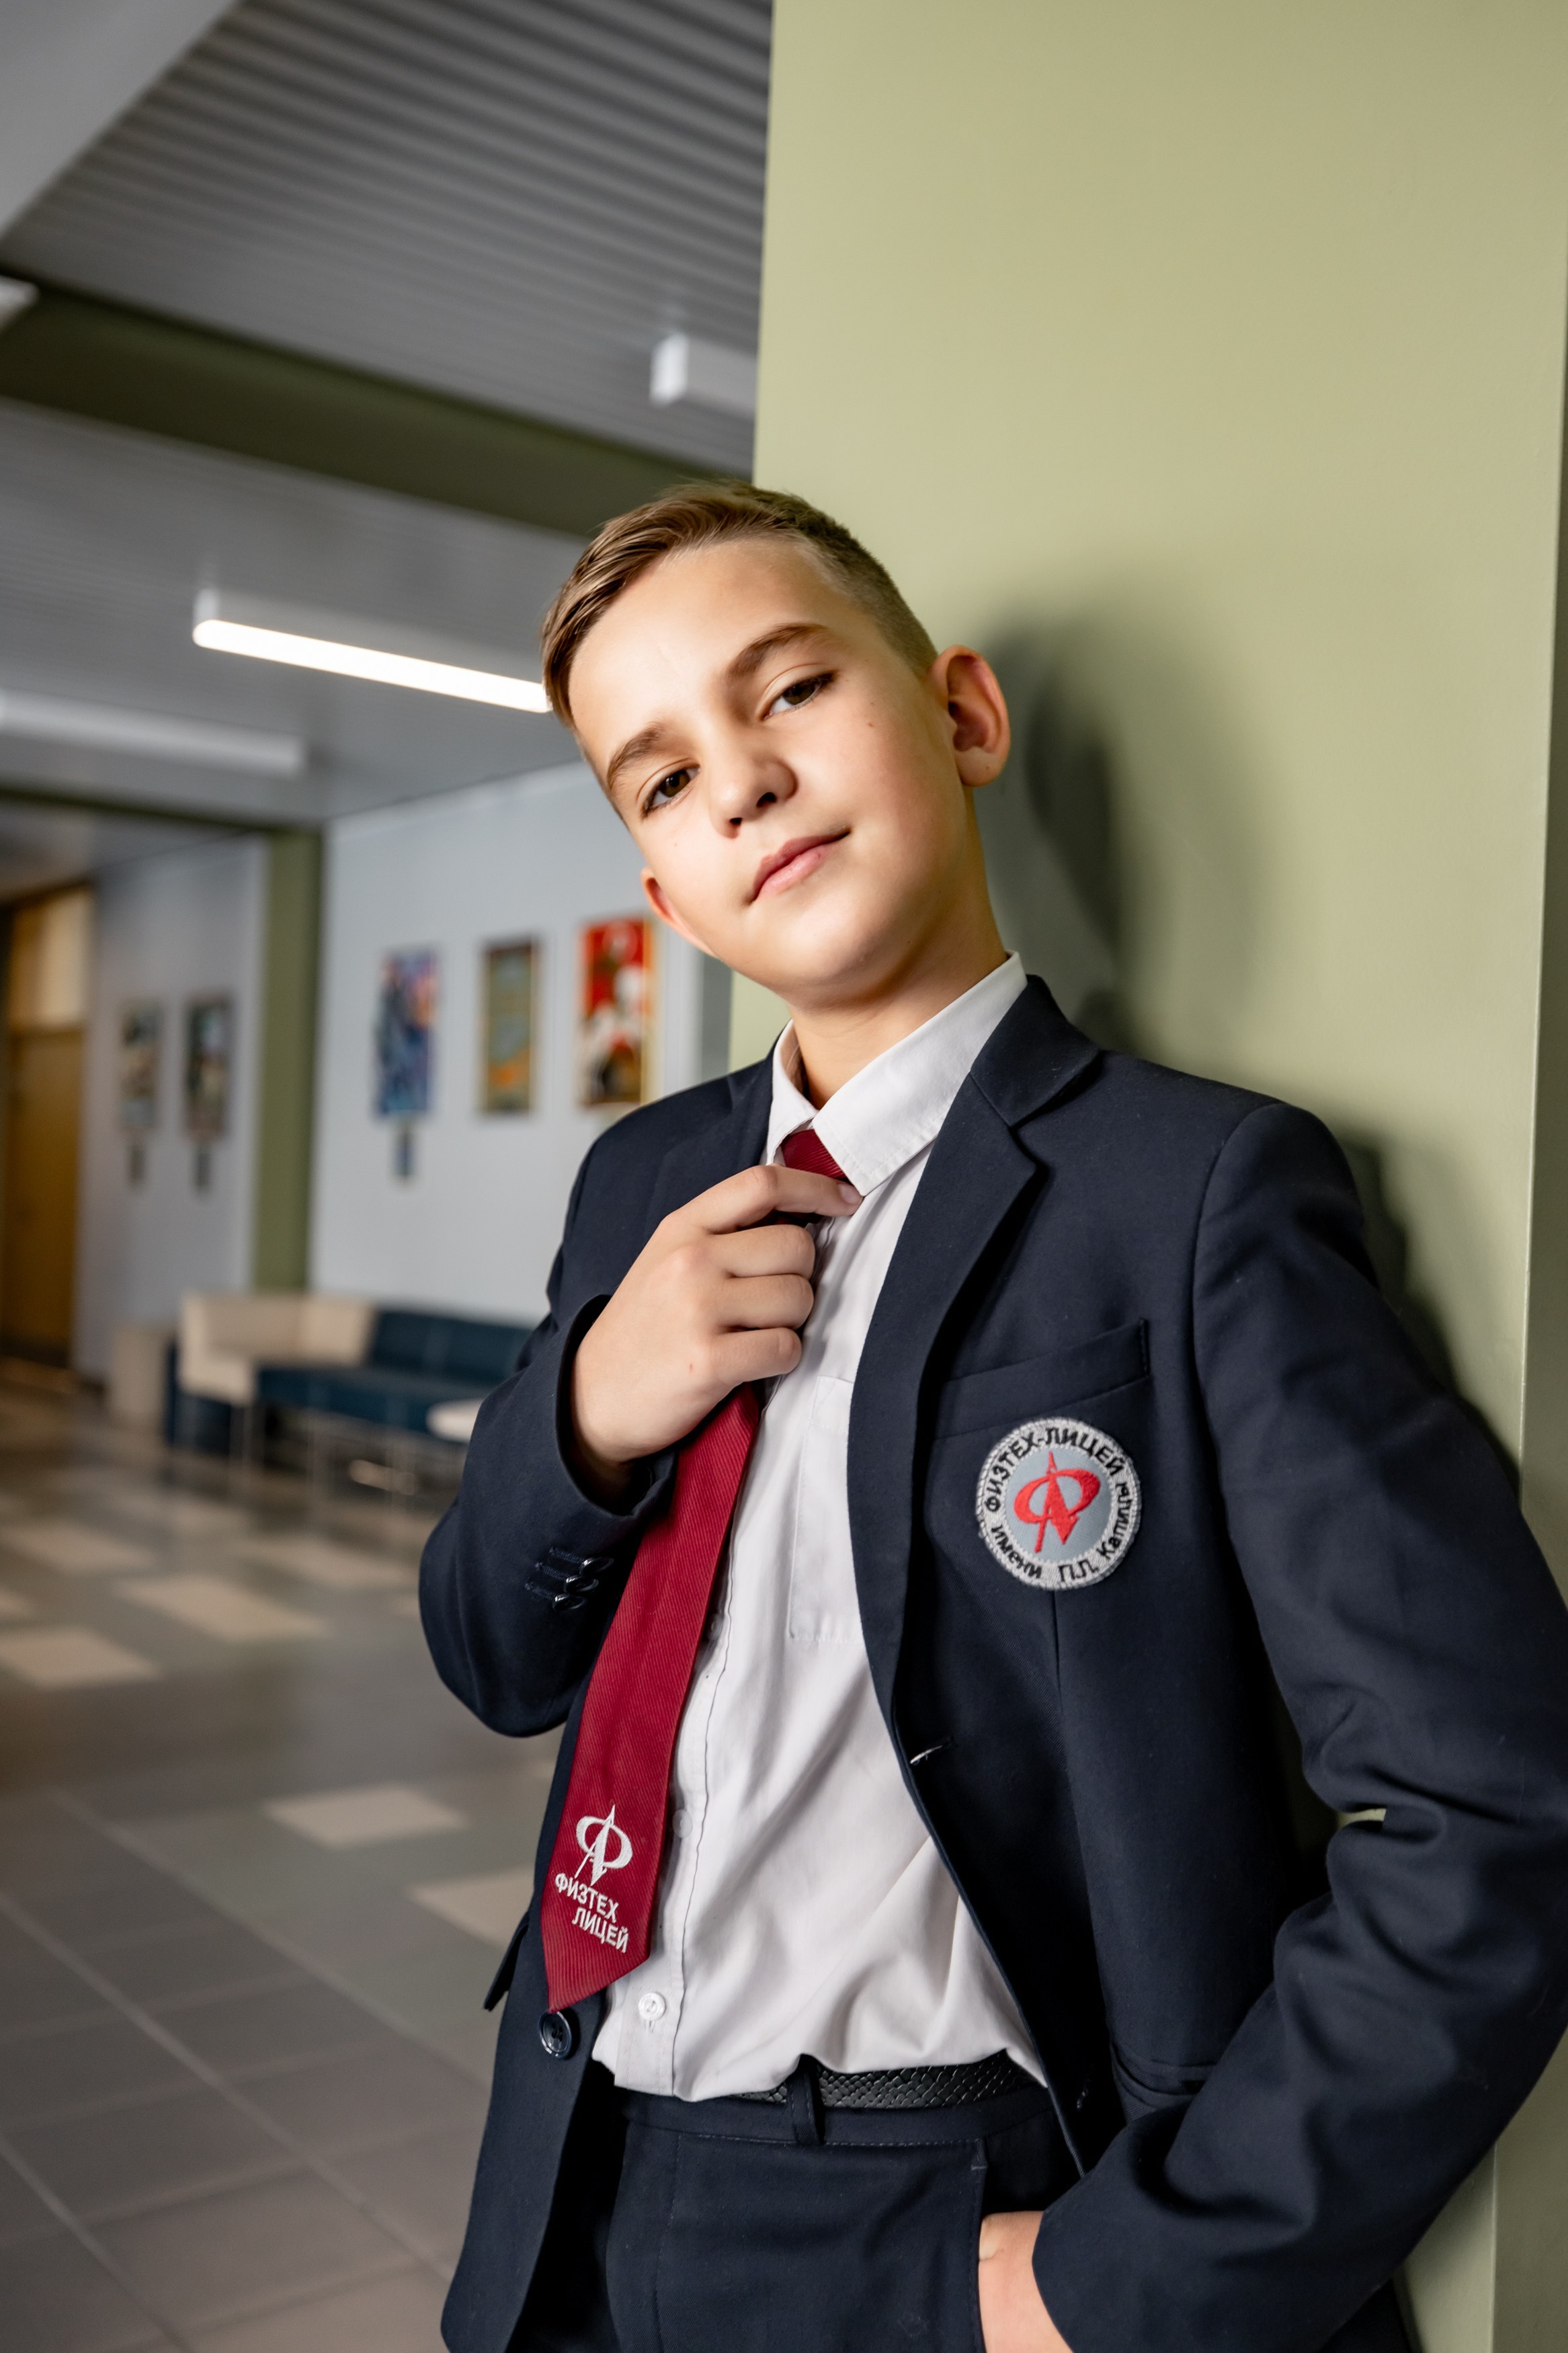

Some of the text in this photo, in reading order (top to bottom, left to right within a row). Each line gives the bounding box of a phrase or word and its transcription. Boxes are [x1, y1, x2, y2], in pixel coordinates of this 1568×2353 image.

[985, 1428, 1126, 1512] ФИЗТЕХ-ЛИЦЕЙ
[991, 1525, 1042, 1579] имени
[1096, 1482, 1132, 1560] Капицы
[555, 1873, 619, 1923] ФИЗТЕХ
[572, 1907, 629, 1953] ЛИЦЕЙ
